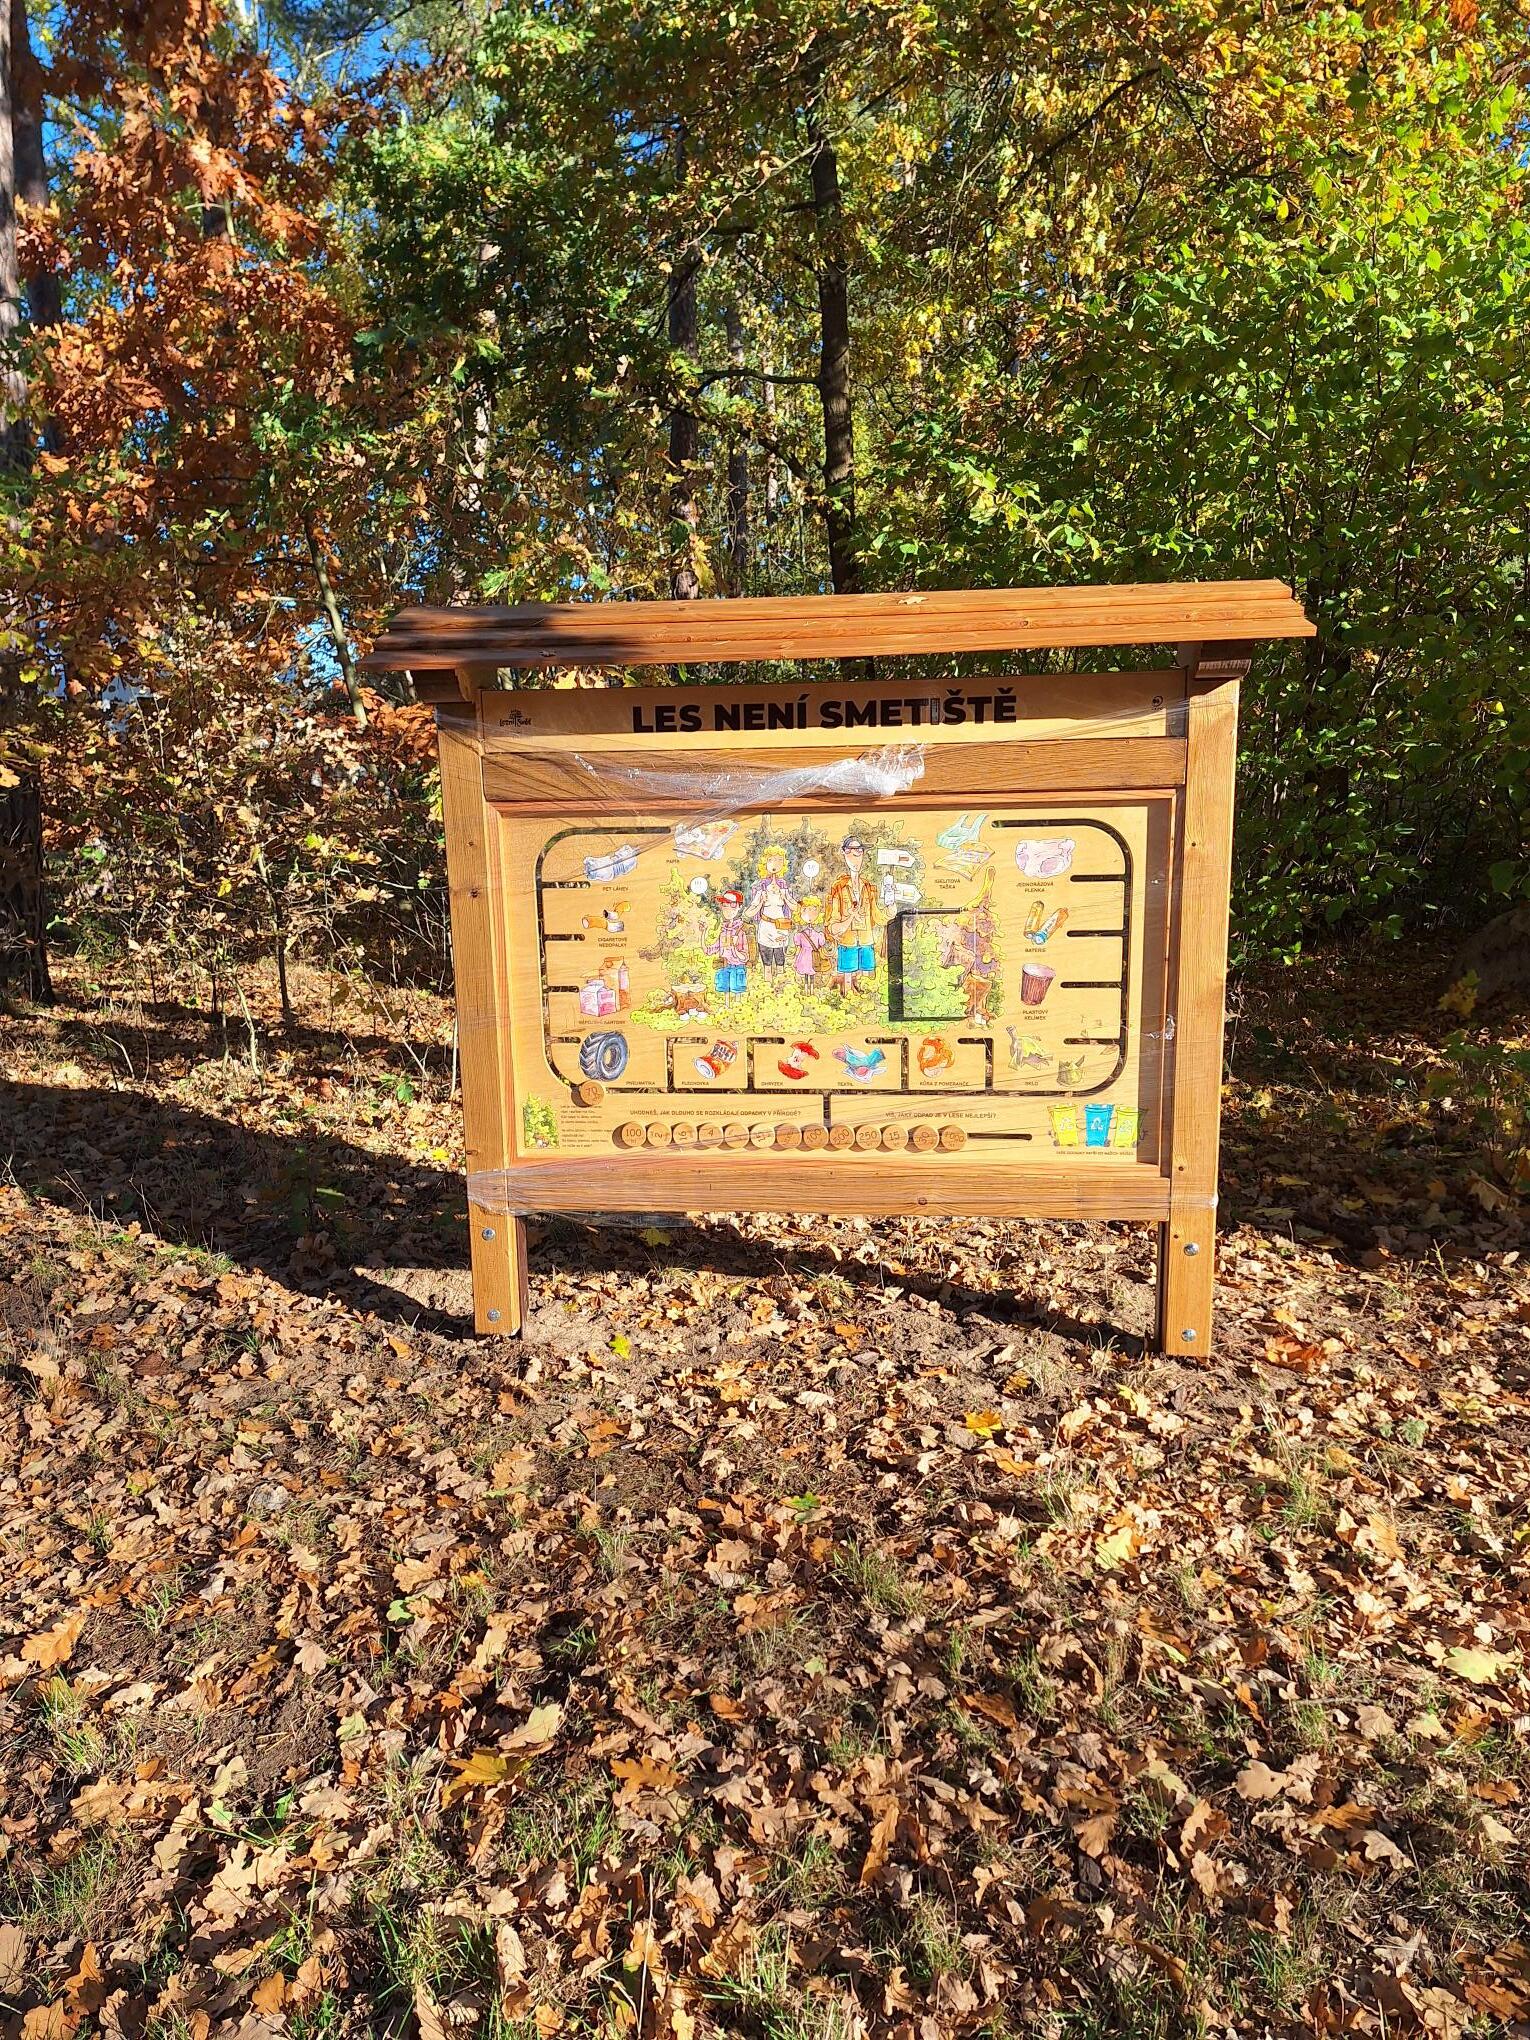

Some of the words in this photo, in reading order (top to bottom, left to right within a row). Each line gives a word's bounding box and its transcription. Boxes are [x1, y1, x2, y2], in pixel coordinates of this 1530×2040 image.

[632, 704, 702, 734] LES
[714, 693, 811, 731] NENÍ
[819, 686, 1017, 728] SMETIŠTĚ
[625, 1128, 642, 1137] 100
[859, 1130, 878, 1141] 250
[889, 1130, 900, 1141] 15
